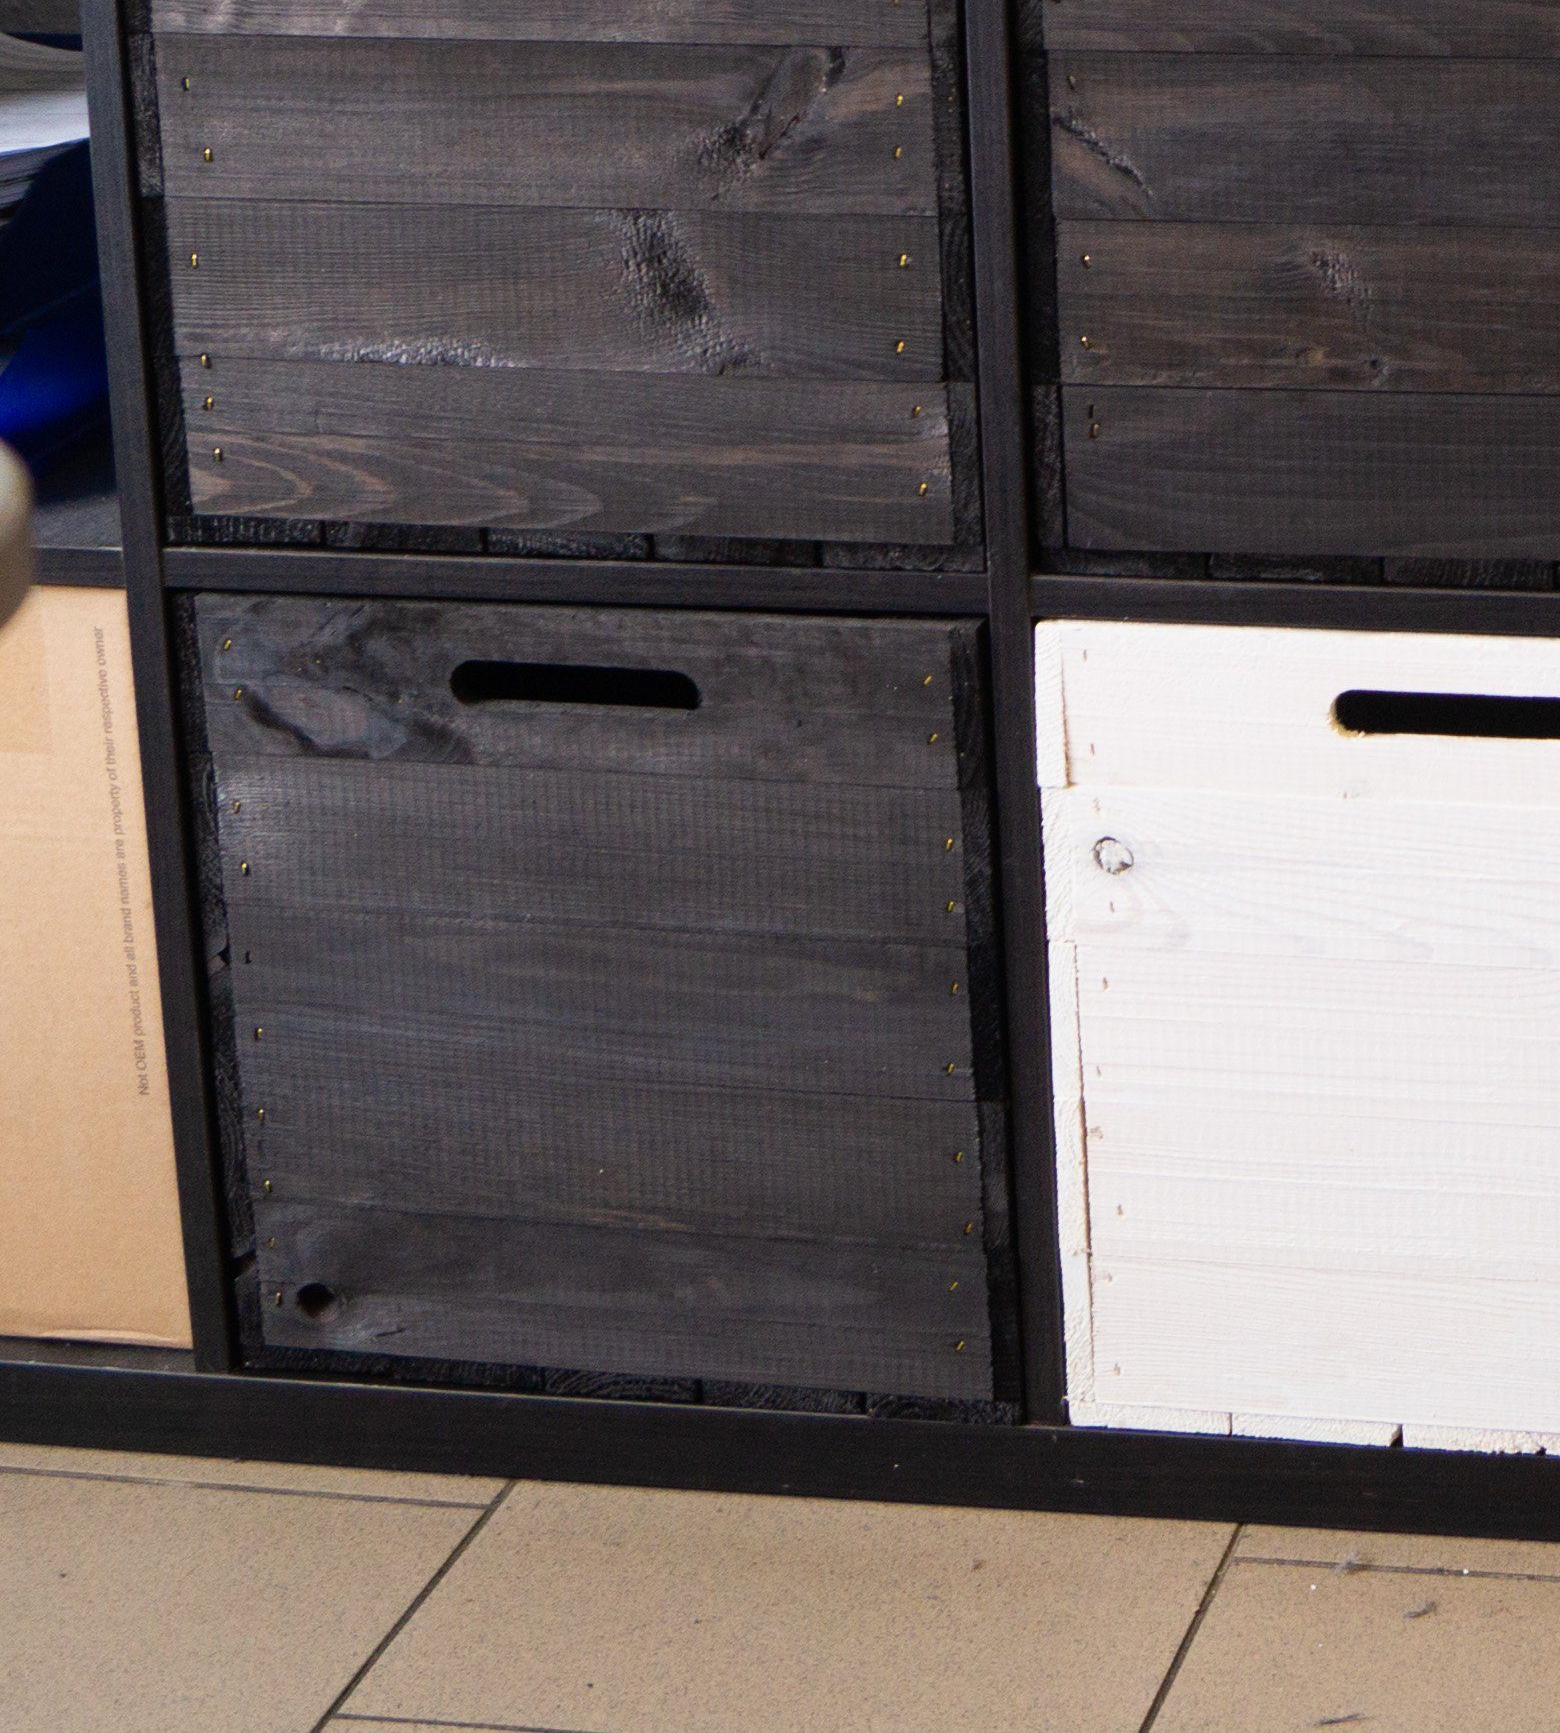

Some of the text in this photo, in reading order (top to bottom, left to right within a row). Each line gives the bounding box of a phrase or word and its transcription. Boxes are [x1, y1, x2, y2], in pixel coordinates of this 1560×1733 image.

[94, 626, 150, 1096] Not OEM product and all brand names are property of their respective owner
